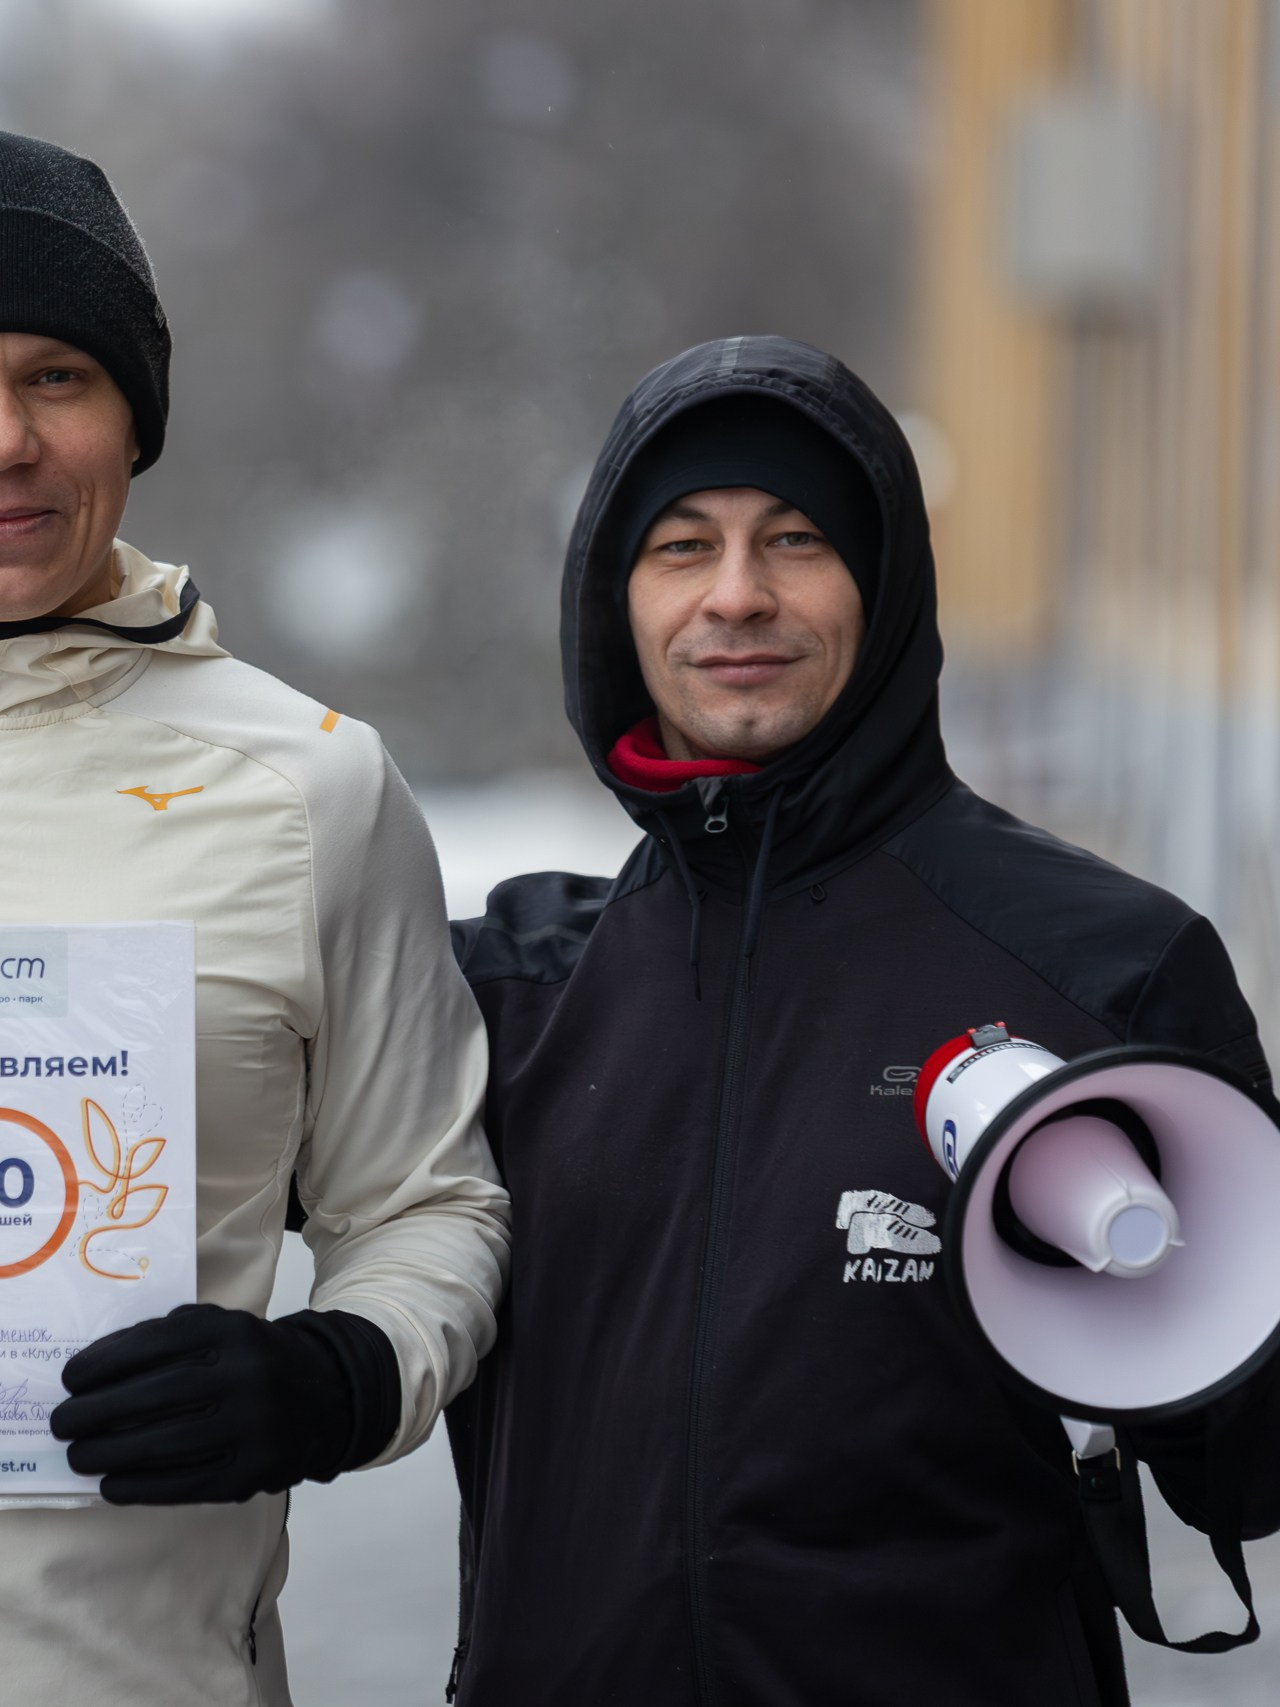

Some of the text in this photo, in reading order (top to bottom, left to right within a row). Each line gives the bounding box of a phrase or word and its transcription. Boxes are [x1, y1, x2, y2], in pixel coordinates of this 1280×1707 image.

[18, 995, 44, 1004] парк
[870, 1084, 914, 1096] Kale
[10, 1350, 18, 1359] в
